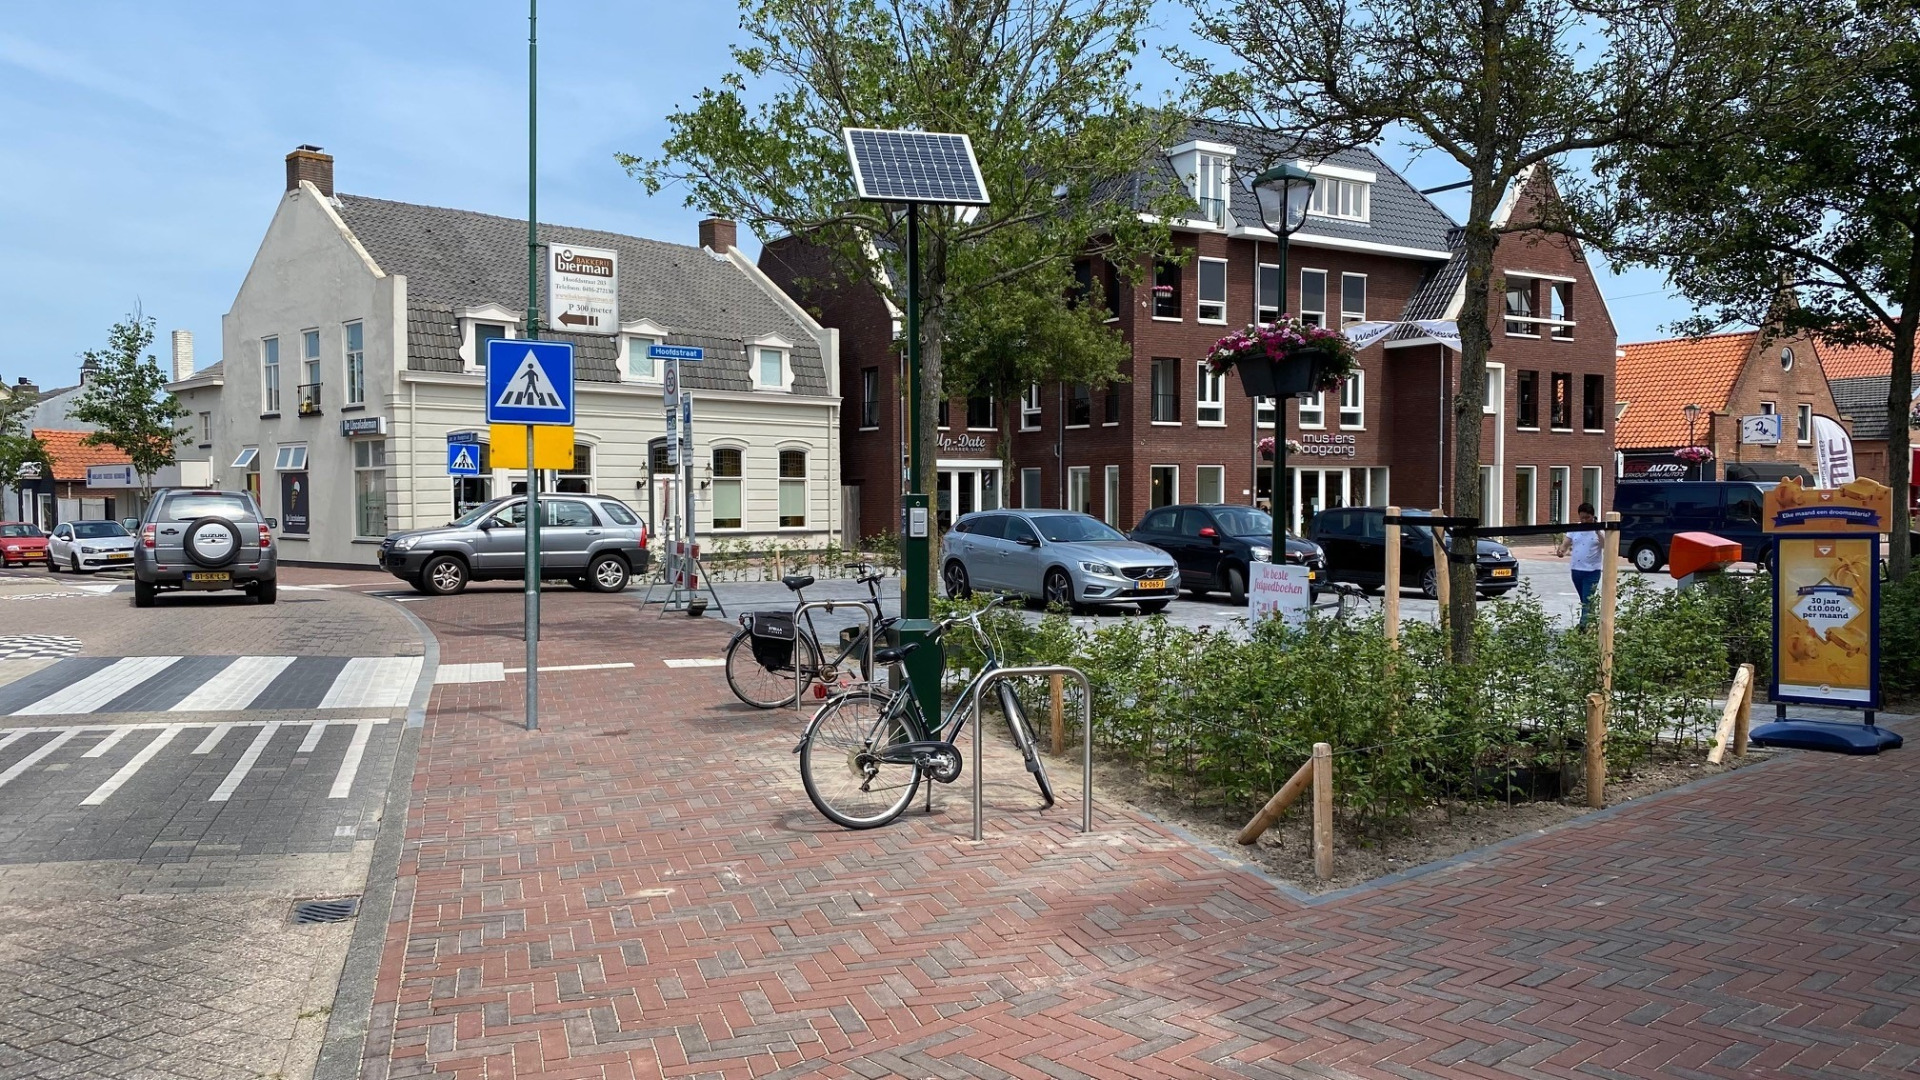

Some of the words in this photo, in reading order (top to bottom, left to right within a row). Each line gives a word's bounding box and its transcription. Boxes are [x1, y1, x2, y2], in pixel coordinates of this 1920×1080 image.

[557, 255, 609, 275] bierman
[568, 303, 574, 311] P
[576, 304, 589, 312] 300
[590, 306, 612, 314] meter
[655, 347, 697, 357] Hoofdstraat
[936, 433, 986, 452] Up-Date
[1302, 445, 1355, 456] oogzorg
[1270, 569, 1289, 581] beste
[1823, 598, 1840, 606] jaar
[1819, 612, 1849, 620] maand
